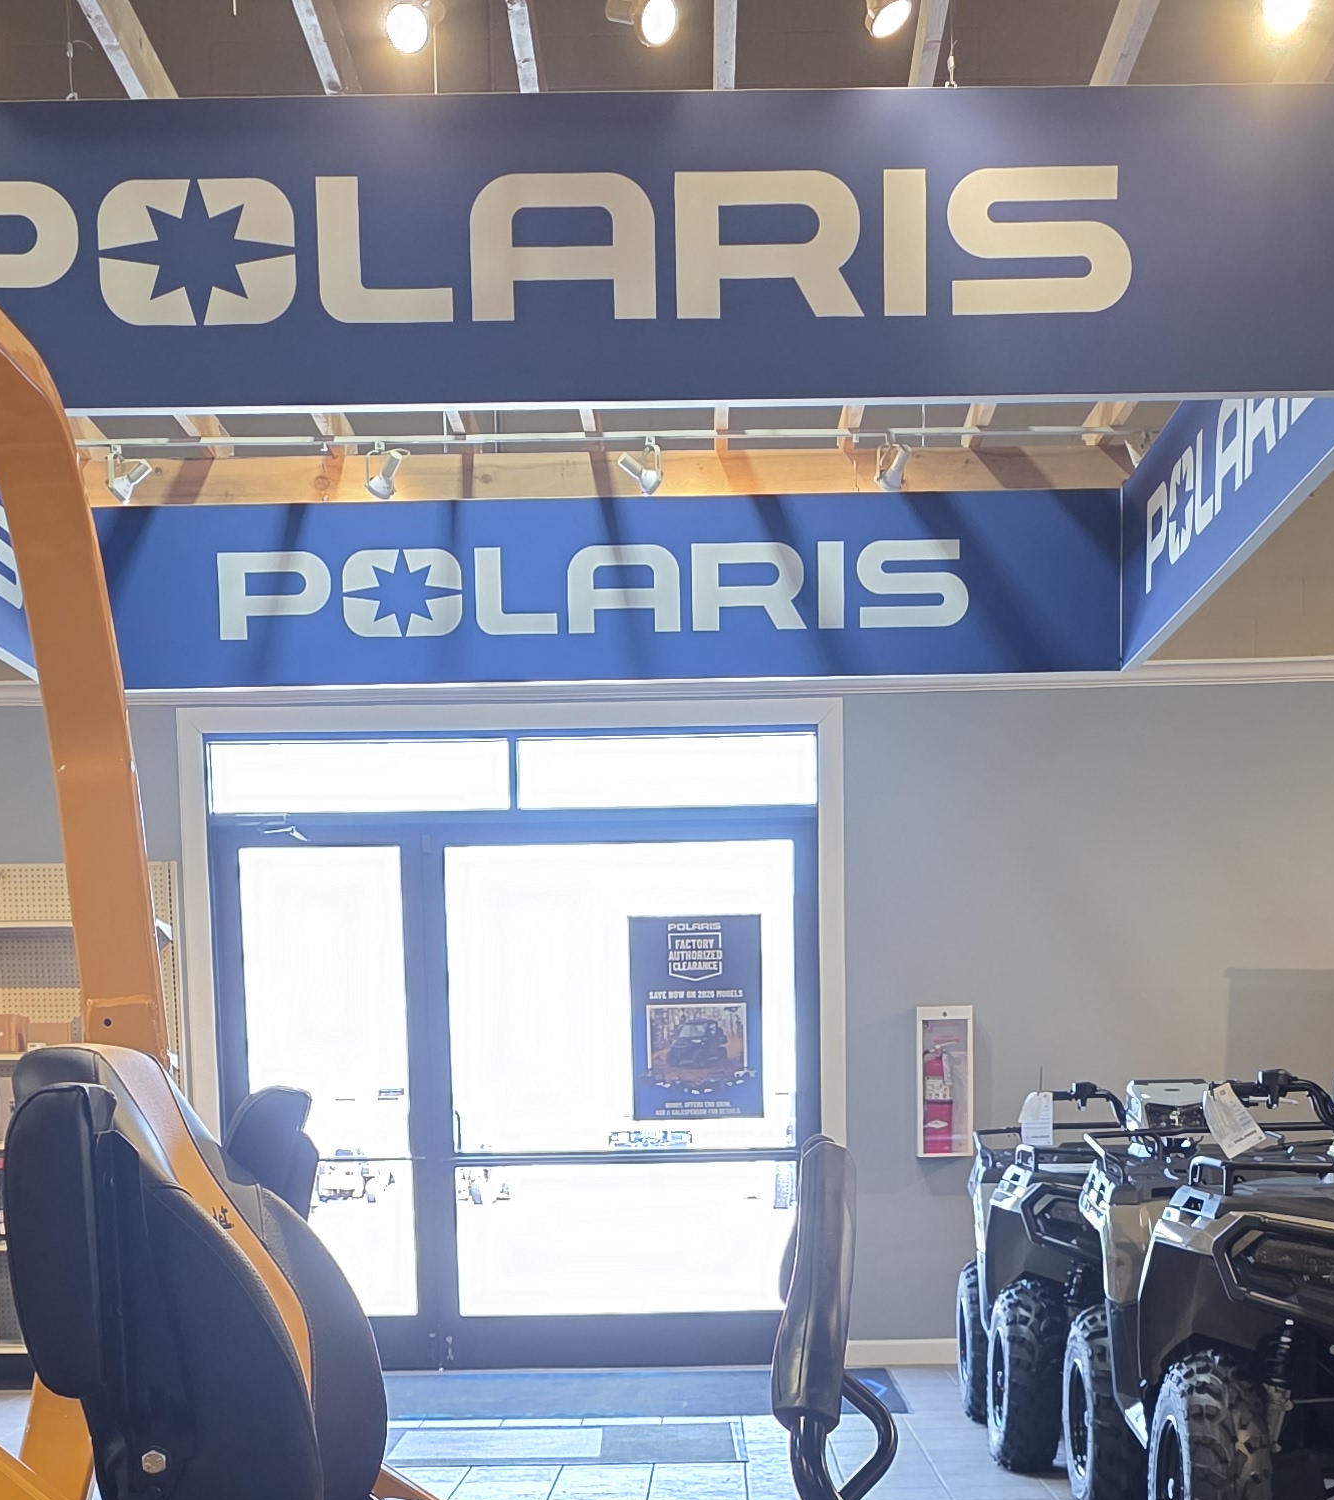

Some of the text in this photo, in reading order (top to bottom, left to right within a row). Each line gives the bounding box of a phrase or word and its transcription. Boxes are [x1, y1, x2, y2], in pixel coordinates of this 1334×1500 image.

[216, 539, 970, 641] POLARIS
[668, 922, 721, 930] POLARIS
[675, 939, 714, 949] FACTORY
[669, 950, 722, 960] AUTHORIZED
[673, 961, 718, 971] CLEARANCE
[649, 991, 667, 999] SAVE
